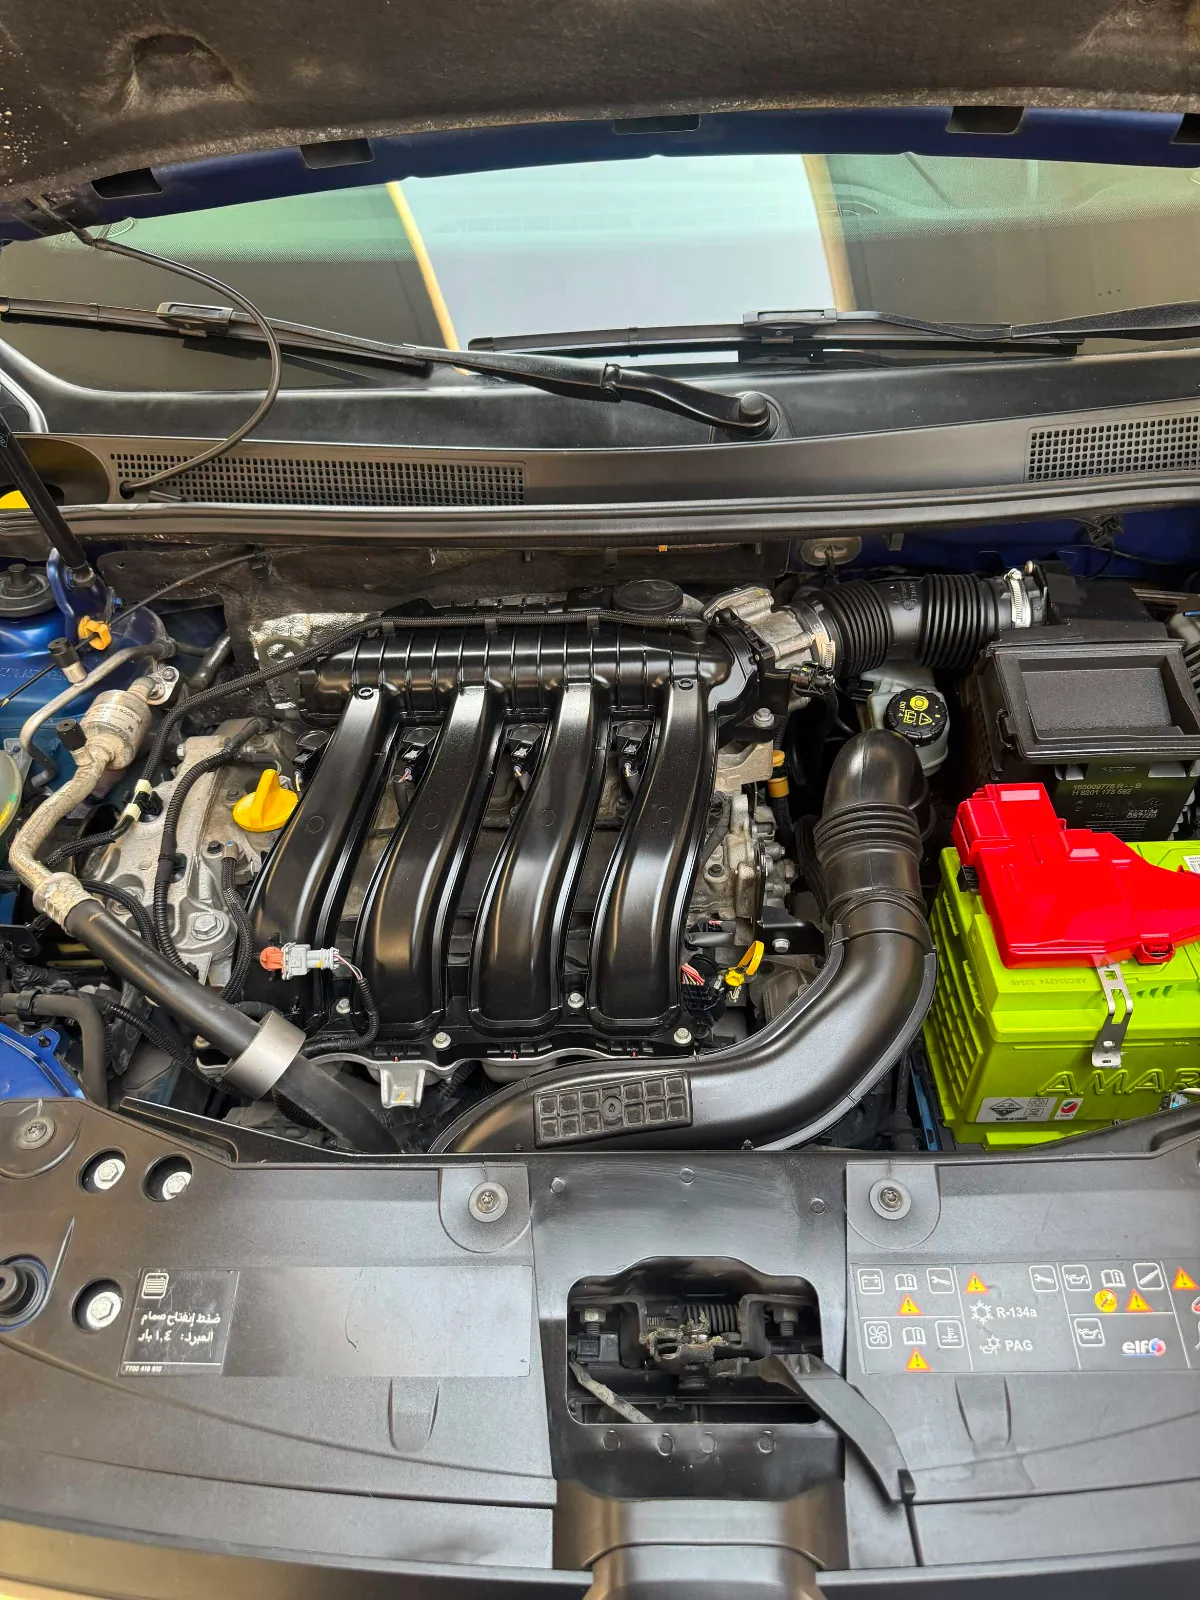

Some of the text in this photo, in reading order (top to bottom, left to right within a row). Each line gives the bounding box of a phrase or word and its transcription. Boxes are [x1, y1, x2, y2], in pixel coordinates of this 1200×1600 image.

[140, 1310, 167, 1326] صمام
[995, 1306, 1038, 1318] R-134a
[137, 1328, 153, 1343] بار
[1004, 1339, 1034, 1351] PAG
